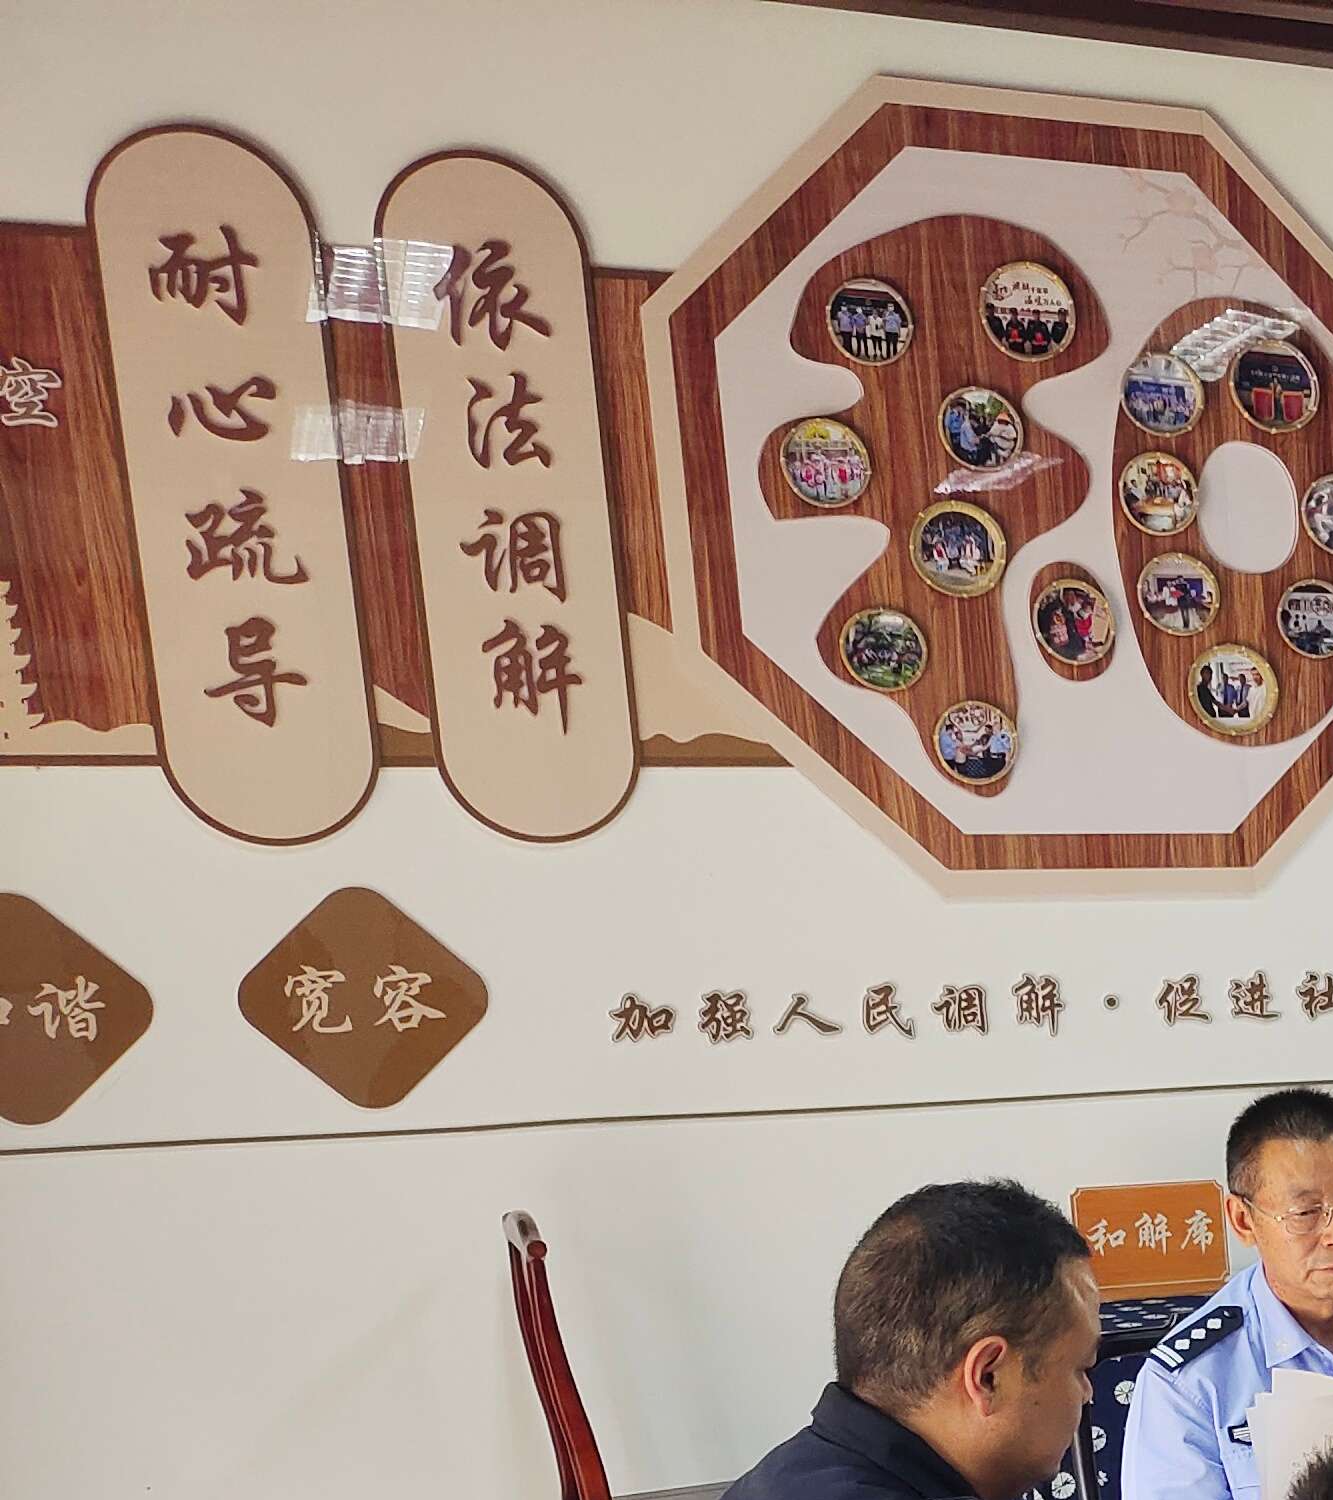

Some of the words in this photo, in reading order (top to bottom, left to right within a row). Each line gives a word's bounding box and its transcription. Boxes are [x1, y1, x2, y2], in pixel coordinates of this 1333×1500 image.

[150, 225, 310, 728] 耐心疏导
[433, 241, 584, 736] 依法调解
[0, 975, 106, 1042] 谐
[283, 965, 447, 1034] 宽容
[1086, 1209, 1215, 1257] 和解席
